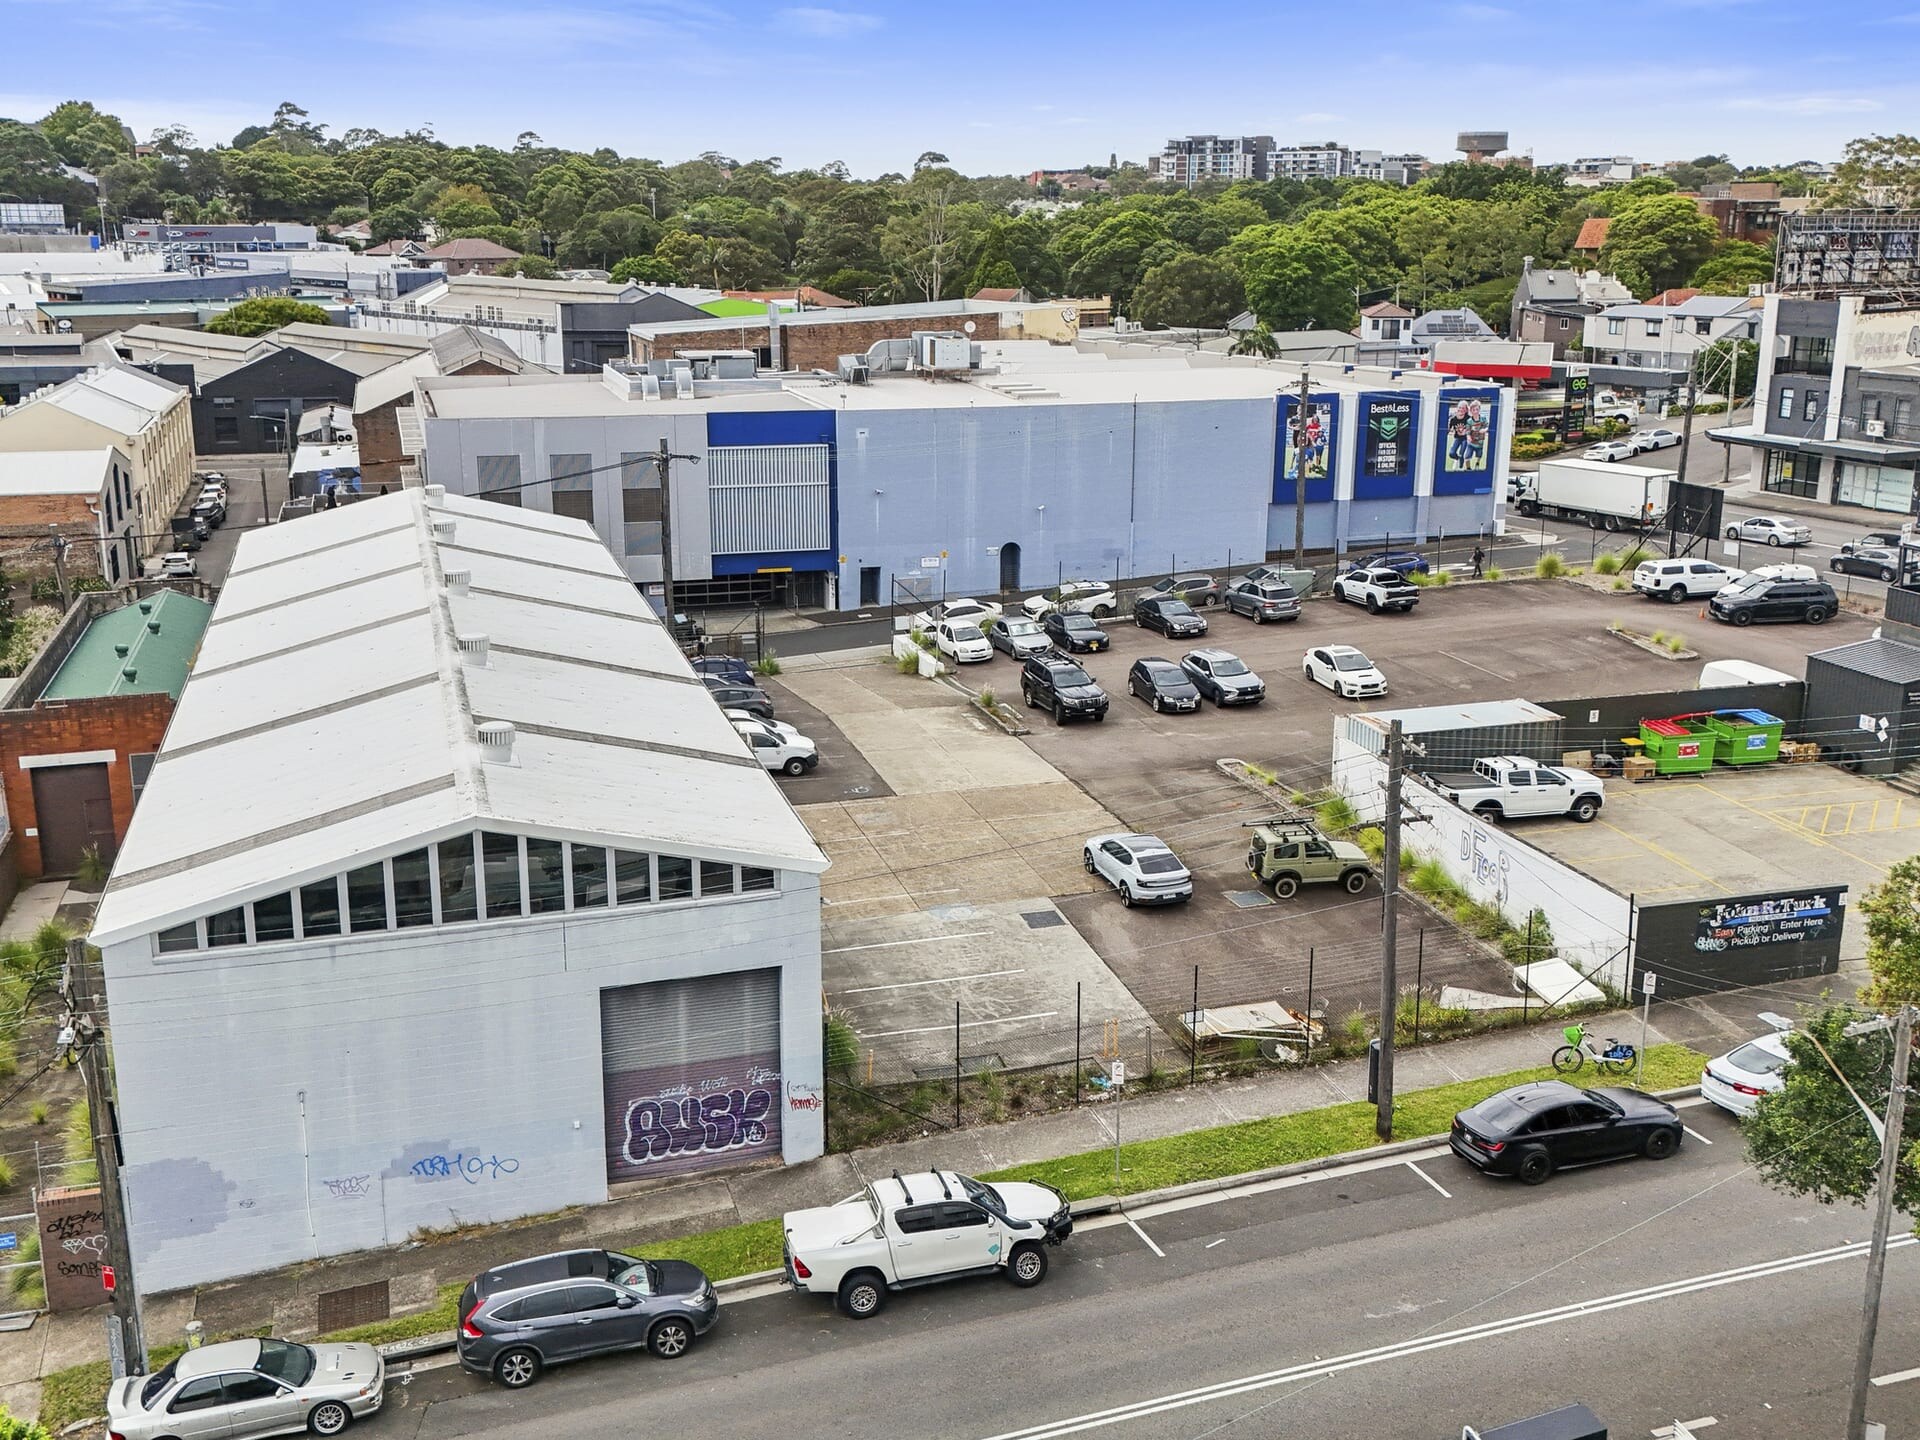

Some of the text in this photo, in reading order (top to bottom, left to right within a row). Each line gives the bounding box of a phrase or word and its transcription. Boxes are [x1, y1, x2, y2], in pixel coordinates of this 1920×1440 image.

[1710, 903, 1761, 927] John
[1780, 917, 1823, 930] Enter Here
[1715, 924, 1769, 939] Easy Parking
[1731, 936, 1760, 946] Pickup
[1761, 935, 1771, 943] or
[1772, 931, 1805, 942] Delivery
